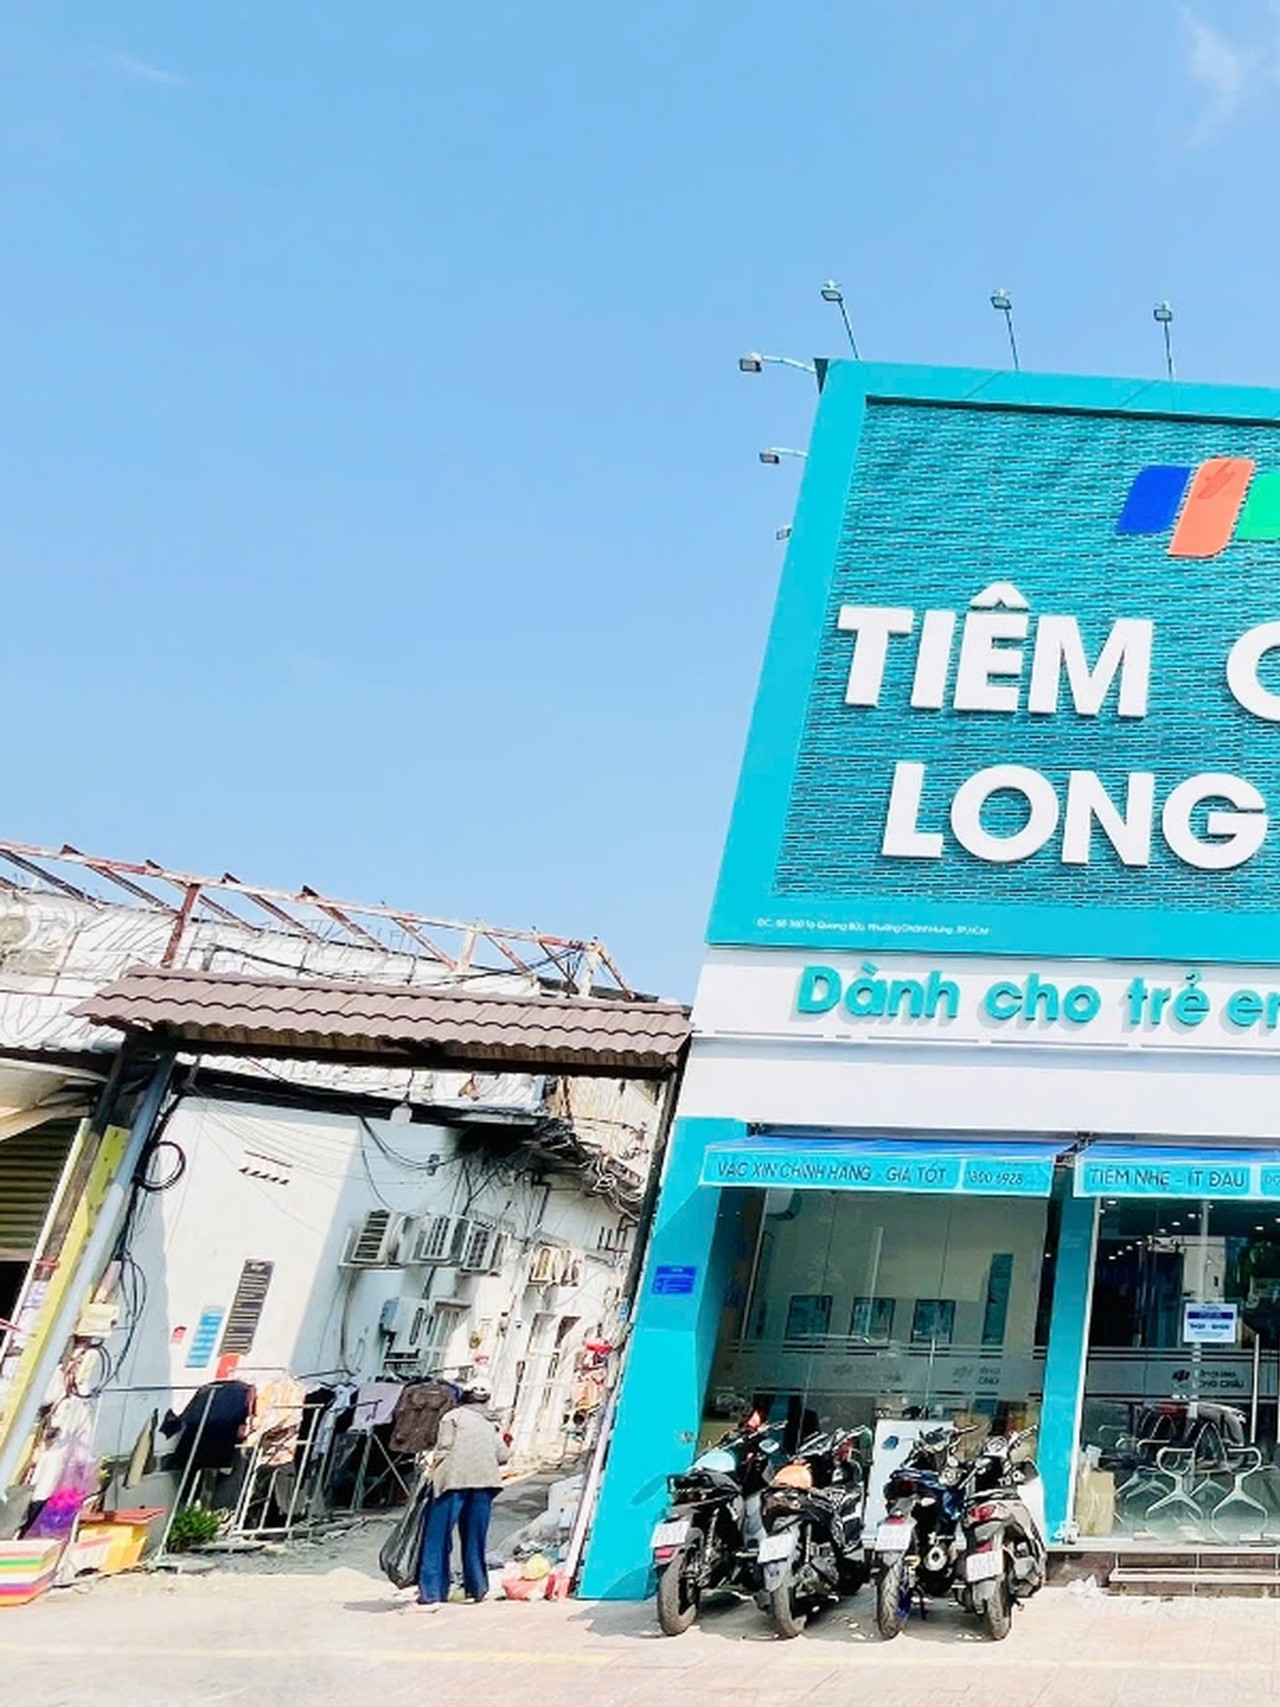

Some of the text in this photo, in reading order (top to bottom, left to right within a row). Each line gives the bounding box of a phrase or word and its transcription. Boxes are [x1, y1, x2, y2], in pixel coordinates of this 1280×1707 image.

[837, 582, 1153, 719] TIÊM
[881, 762, 1270, 872] LONG
[796, 961, 961, 1020] Dành
[983, 973, 1102, 1024] cho
[1126, 968, 1212, 1027] trẻ
[1209, 1170, 1245, 1188] ĐAU
